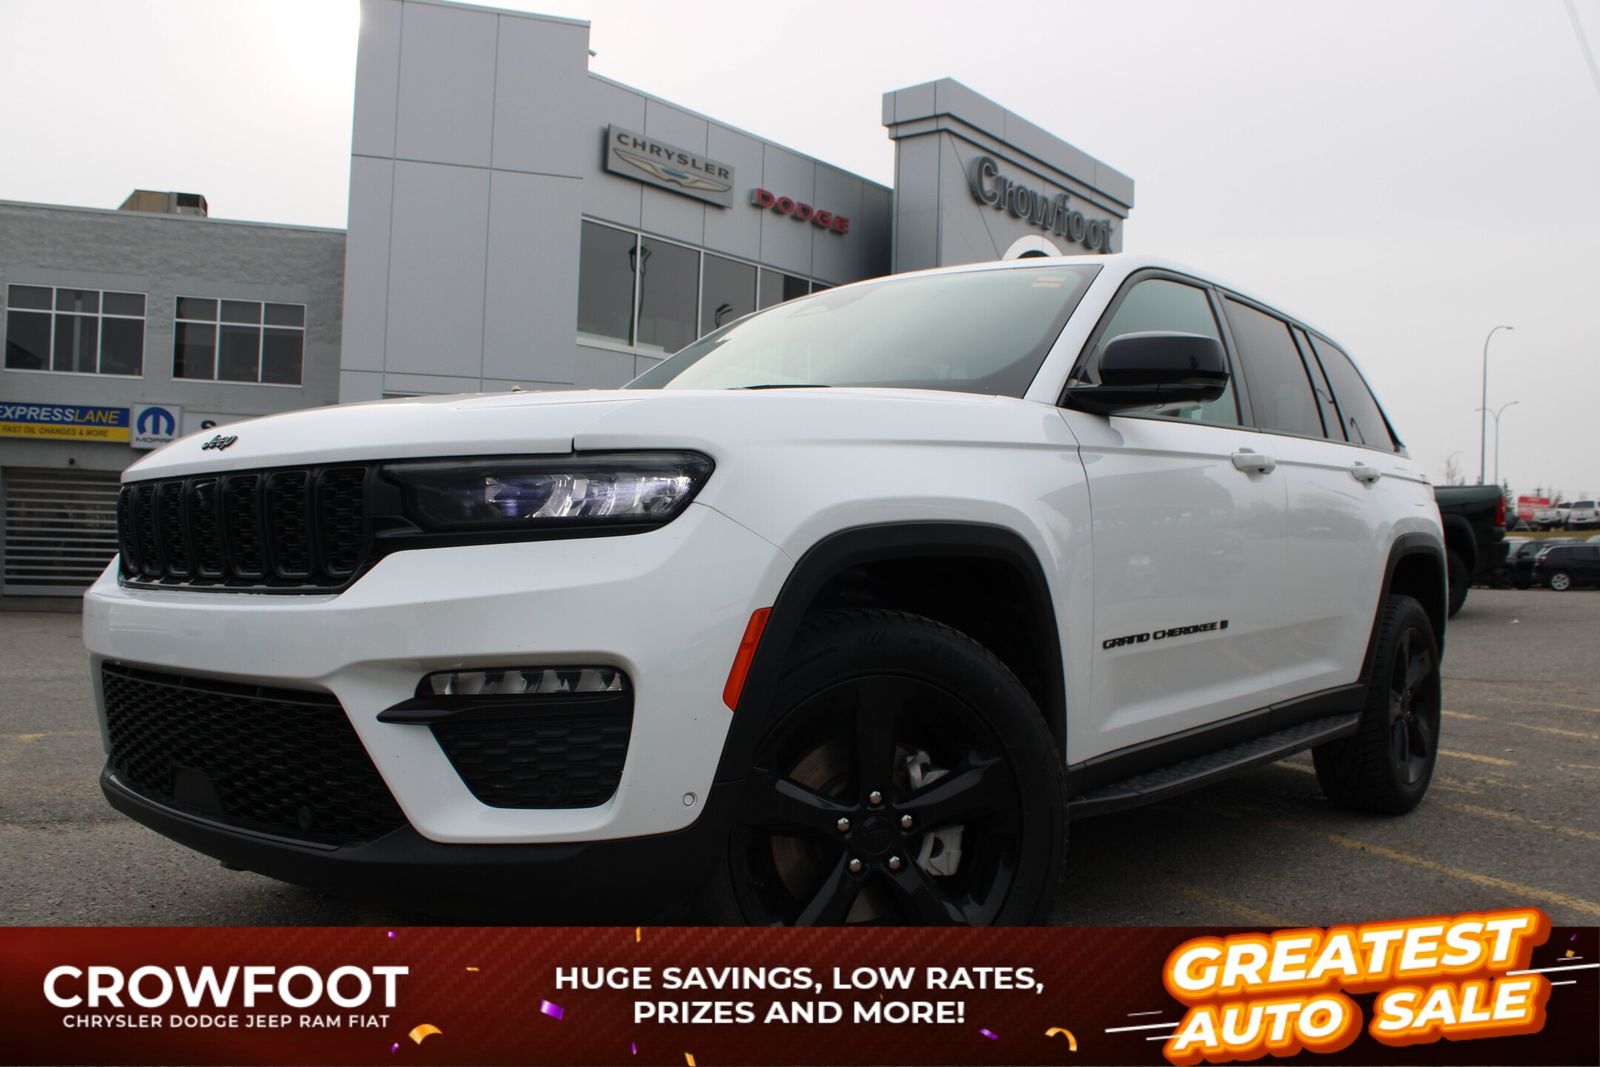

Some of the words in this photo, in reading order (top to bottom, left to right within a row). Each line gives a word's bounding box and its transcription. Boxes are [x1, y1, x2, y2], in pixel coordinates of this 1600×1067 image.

[616, 132, 731, 181] CHRYSLER
[752, 187, 850, 236] DODGE
[970, 155, 1114, 254] Crowfoot
[39, 427, 77, 436] CHANGES
[86, 429, 109, 438] MORE
[202, 434, 238, 451] Jeep
[1102, 632, 1150, 650] GRAND
[1153, 621, 1218, 641] CHEROKEE
